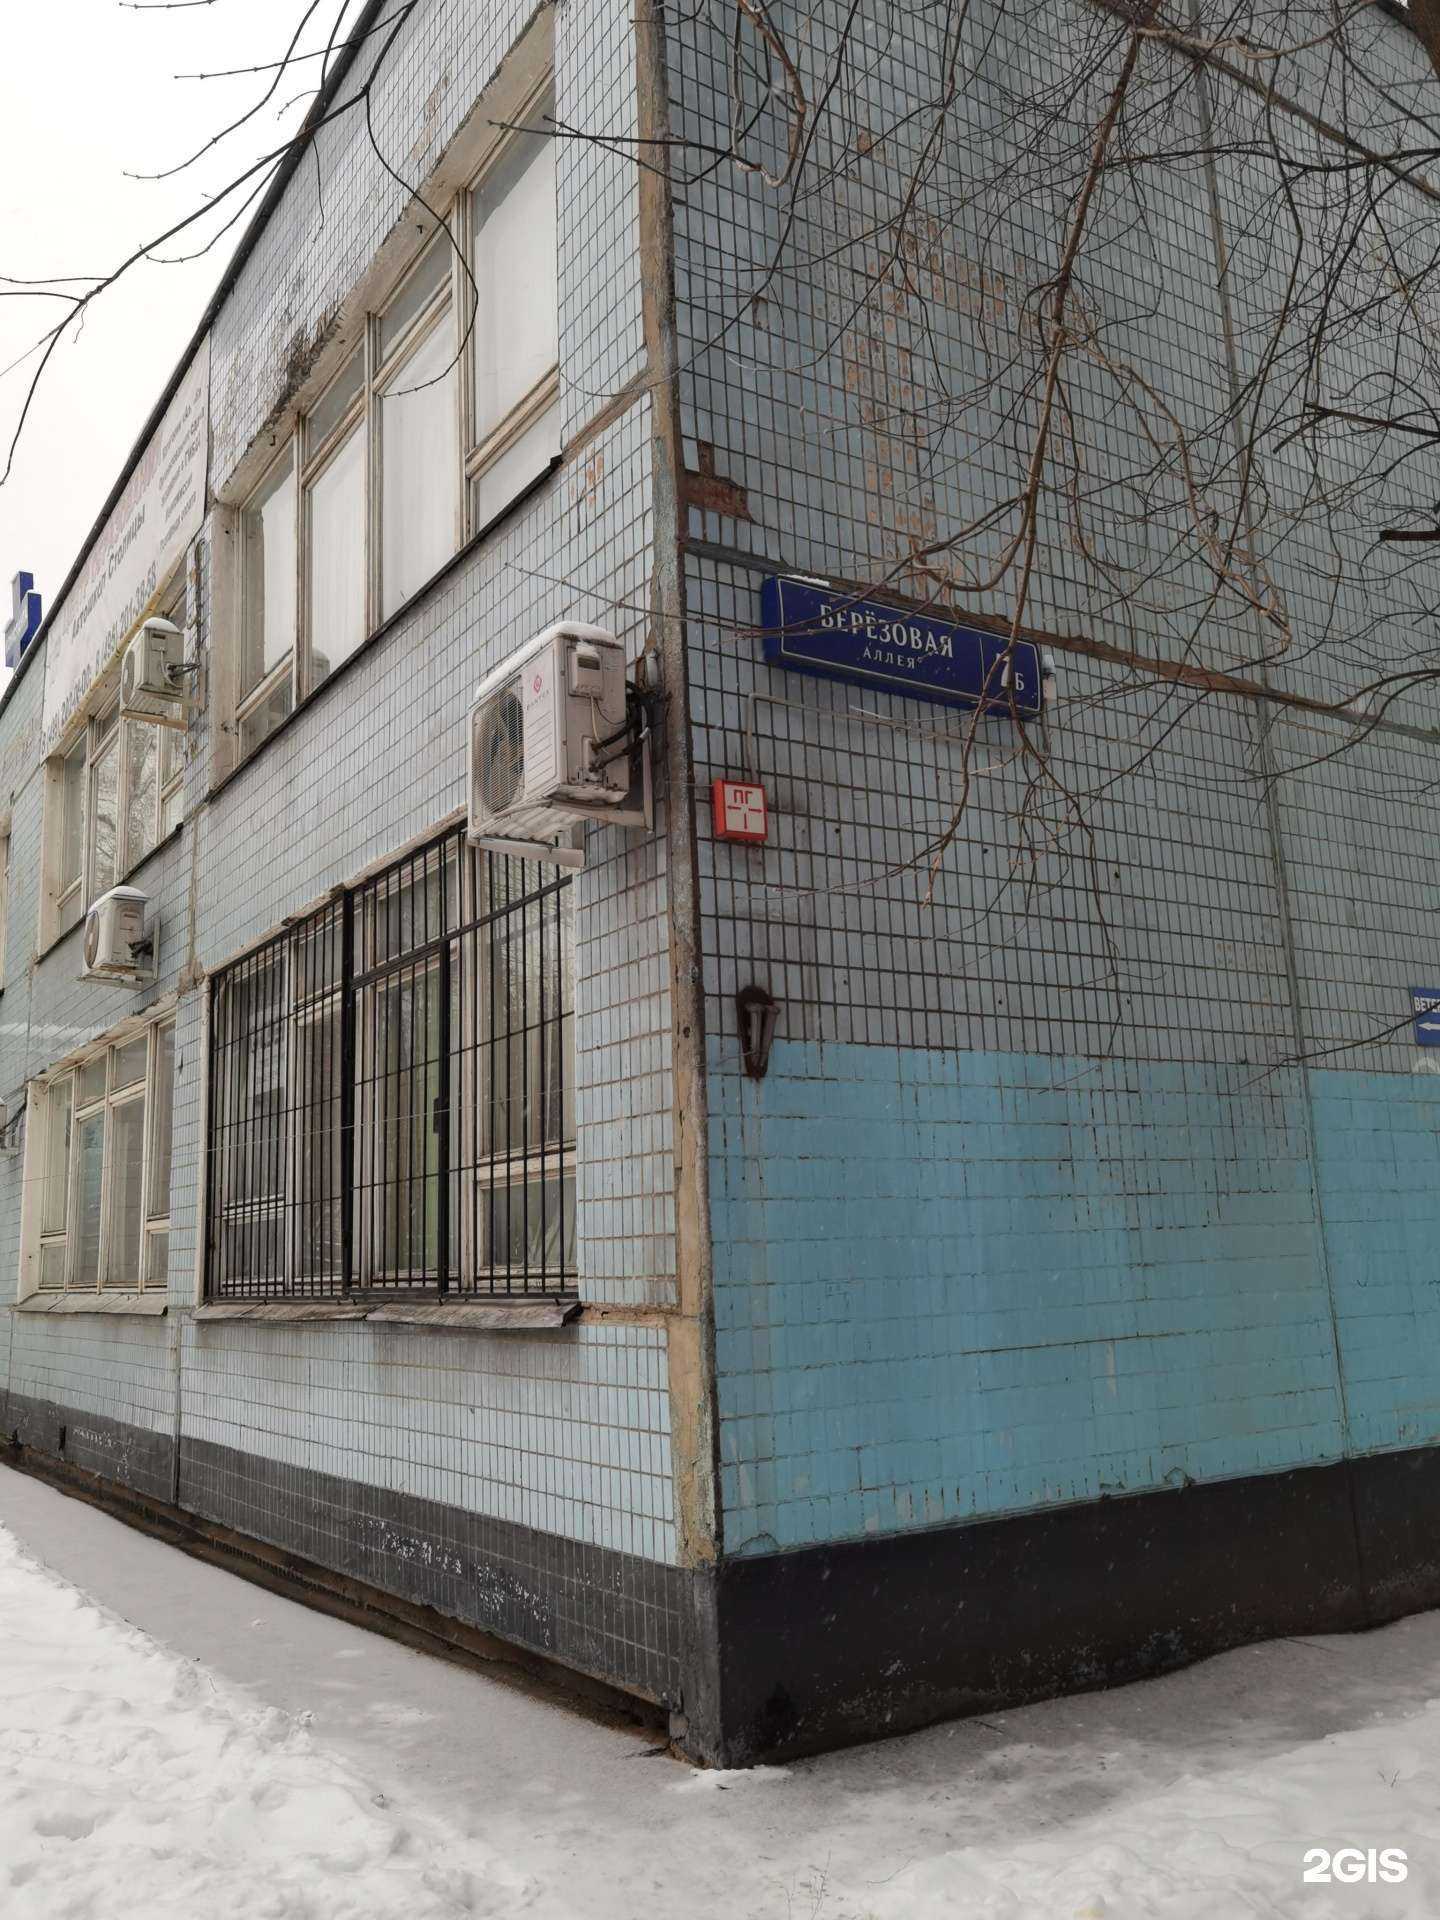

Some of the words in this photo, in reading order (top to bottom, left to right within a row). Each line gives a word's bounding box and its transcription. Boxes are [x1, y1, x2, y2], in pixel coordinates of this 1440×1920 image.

[108, 503, 146, 579] Столицы
[820, 604, 954, 659] БЕРЁЗОВАЯ
[863, 648, 916, 670] АЛЛЕЯ
[733, 789, 753, 804] ПГ
